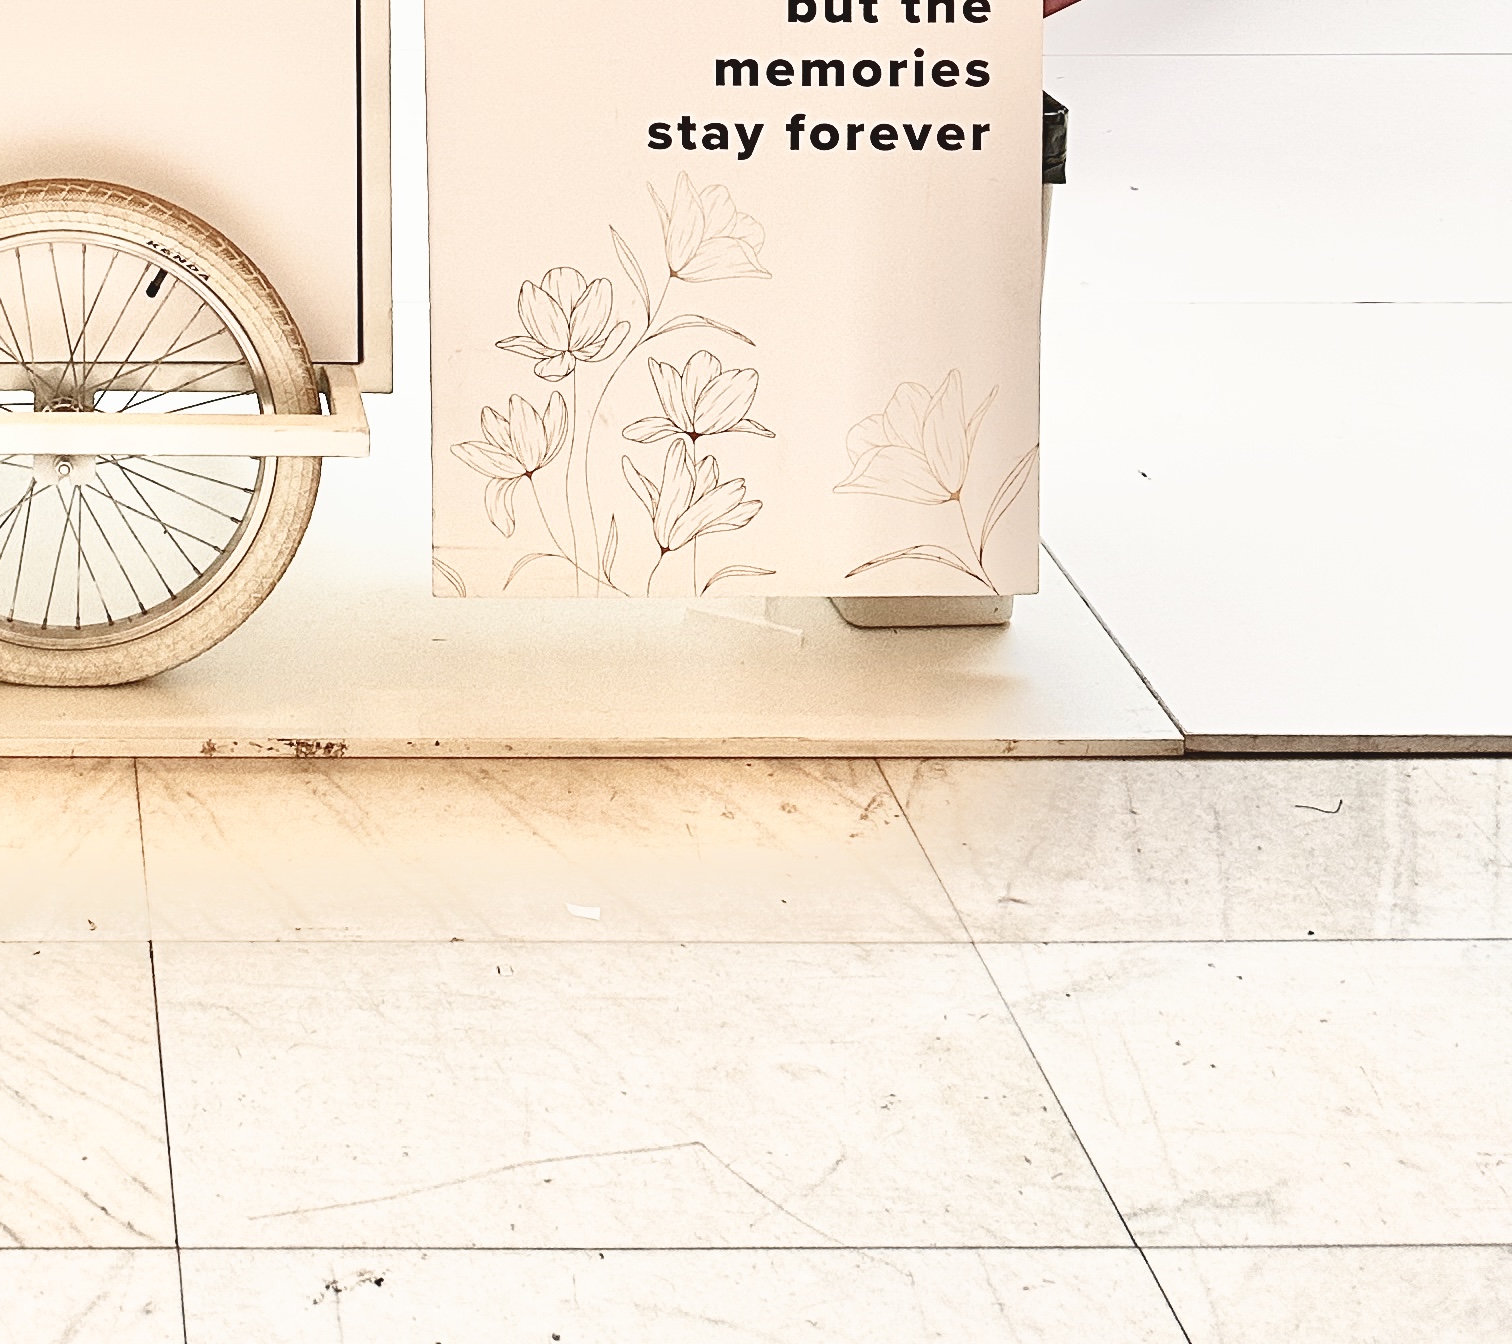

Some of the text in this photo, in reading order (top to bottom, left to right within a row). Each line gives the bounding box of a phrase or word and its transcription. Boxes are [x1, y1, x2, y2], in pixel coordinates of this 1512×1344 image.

[715, 47, 990, 88] memories
[647, 113, 991, 161] stay forever
[145, 239, 211, 282] KENDA
